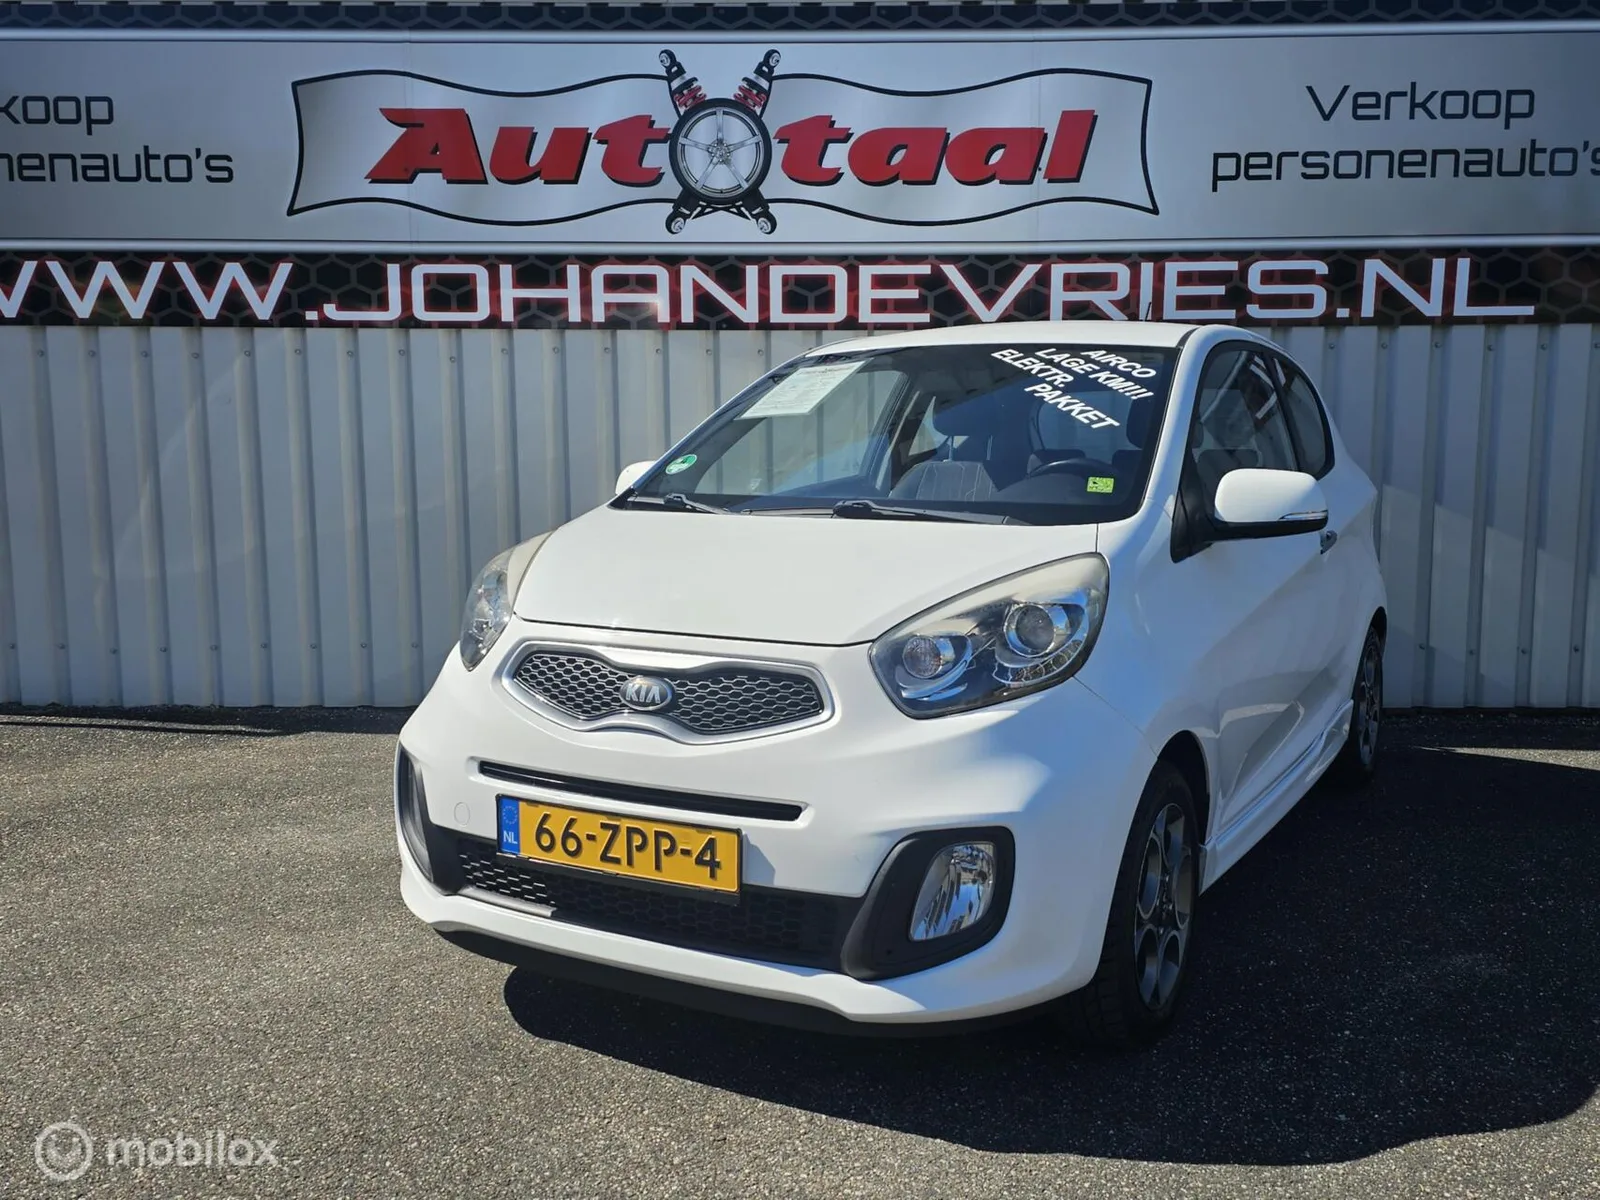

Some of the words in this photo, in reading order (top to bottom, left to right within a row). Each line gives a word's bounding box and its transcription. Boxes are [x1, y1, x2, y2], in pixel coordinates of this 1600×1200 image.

[1306, 81, 1535, 130] Verkoop
[991, 348, 1074, 388] ELEKTR.
[1035, 348, 1101, 374] LAGE
[1088, 370, 1154, 400] KM!!!
[1080, 349, 1157, 379] AIRCO
[1024, 383, 1120, 429] PAKKET
[625, 683, 662, 704] KIA
[503, 831, 518, 845] NL
[534, 812, 722, 880] 66-ZPP-4
